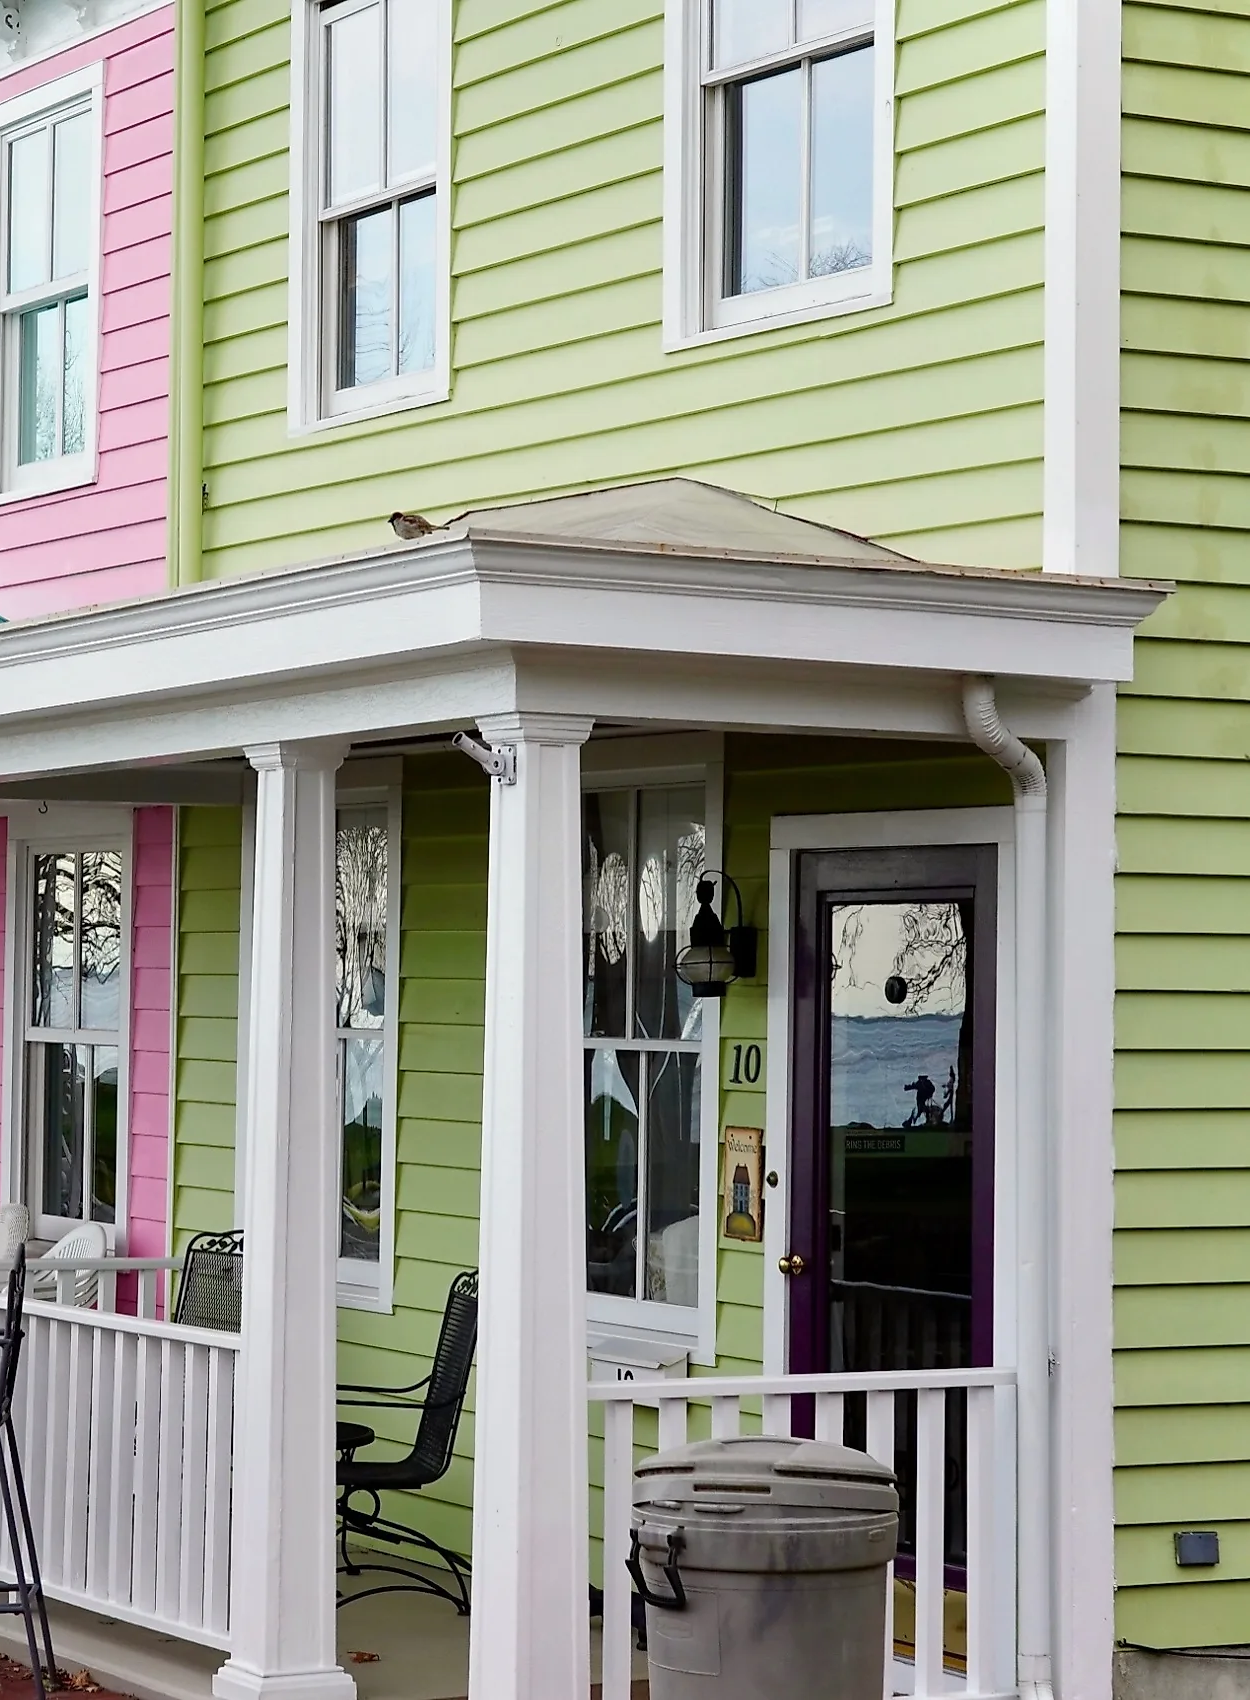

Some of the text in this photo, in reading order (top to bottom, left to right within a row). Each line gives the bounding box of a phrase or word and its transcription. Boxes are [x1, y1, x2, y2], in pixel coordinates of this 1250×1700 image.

[729, 1043, 762, 1084] 10
[727, 1138, 758, 1154] Welcome
[863, 1139, 876, 1149] THE
